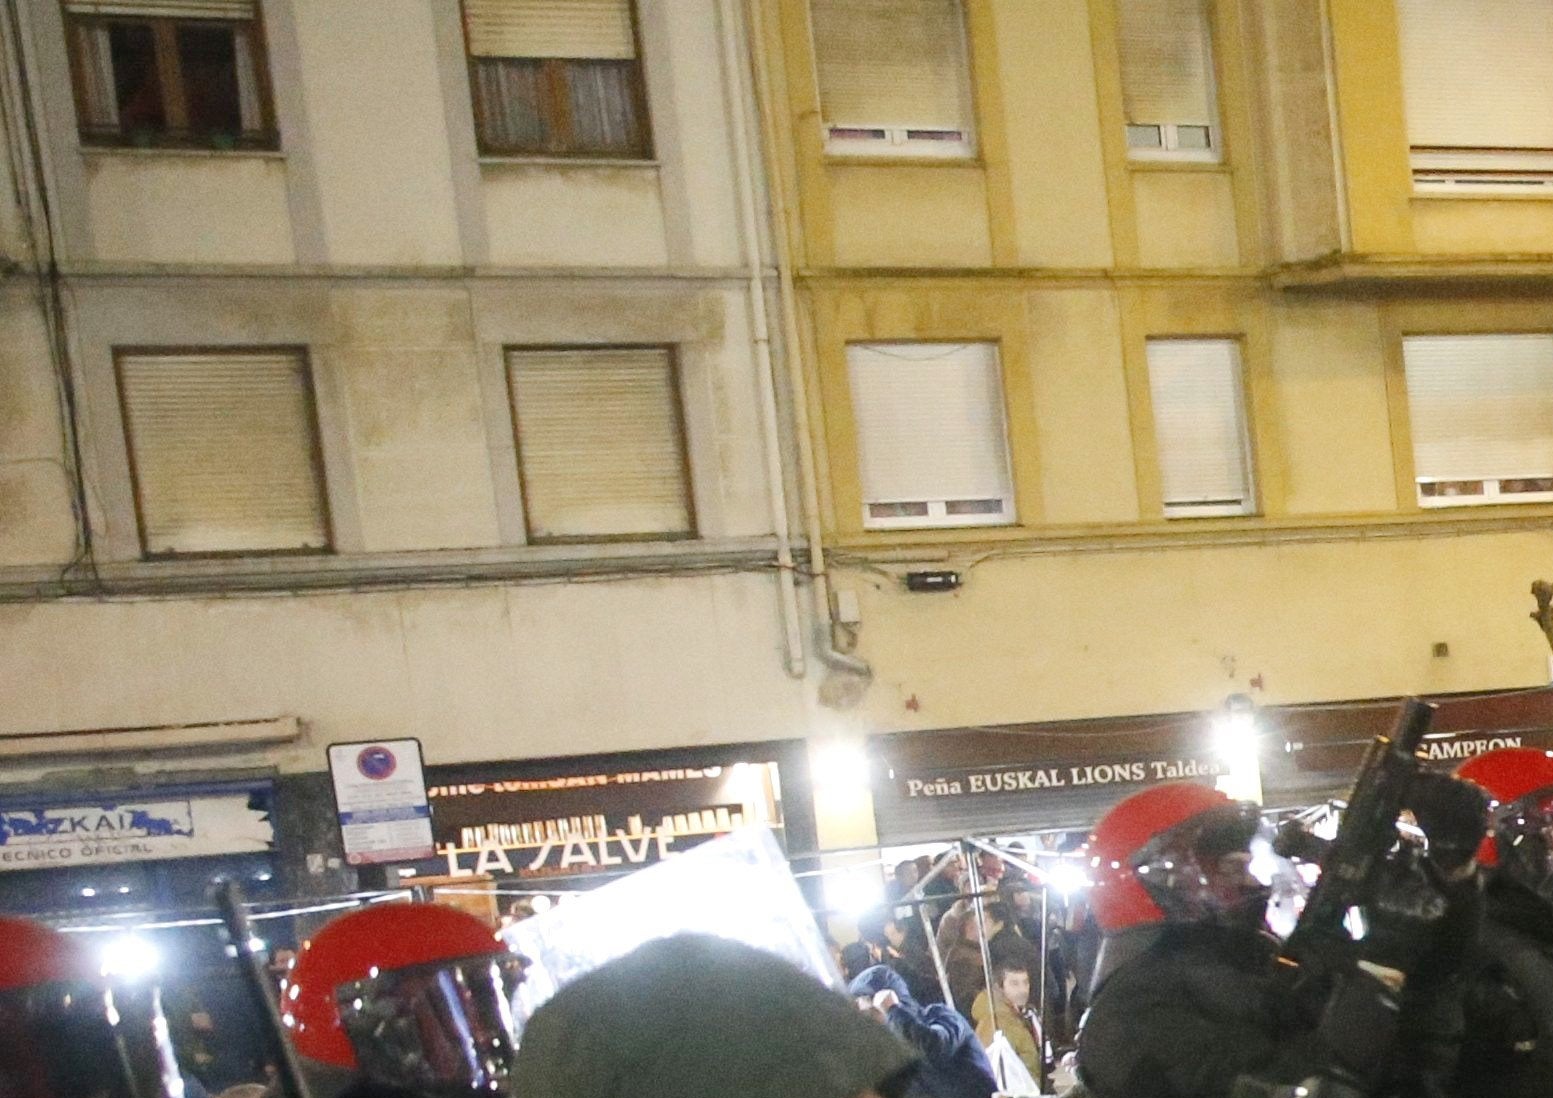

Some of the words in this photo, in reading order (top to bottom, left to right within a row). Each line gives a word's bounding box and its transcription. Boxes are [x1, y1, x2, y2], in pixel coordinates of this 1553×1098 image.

[907, 778, 963, 797] Peña
[968, 768, 1065, 793] EUSKAL
[1070, 762, 1145, 786] LIONS
[2, 847, 72, 862] ECNICO
[446, 842, 514, 877] LA
